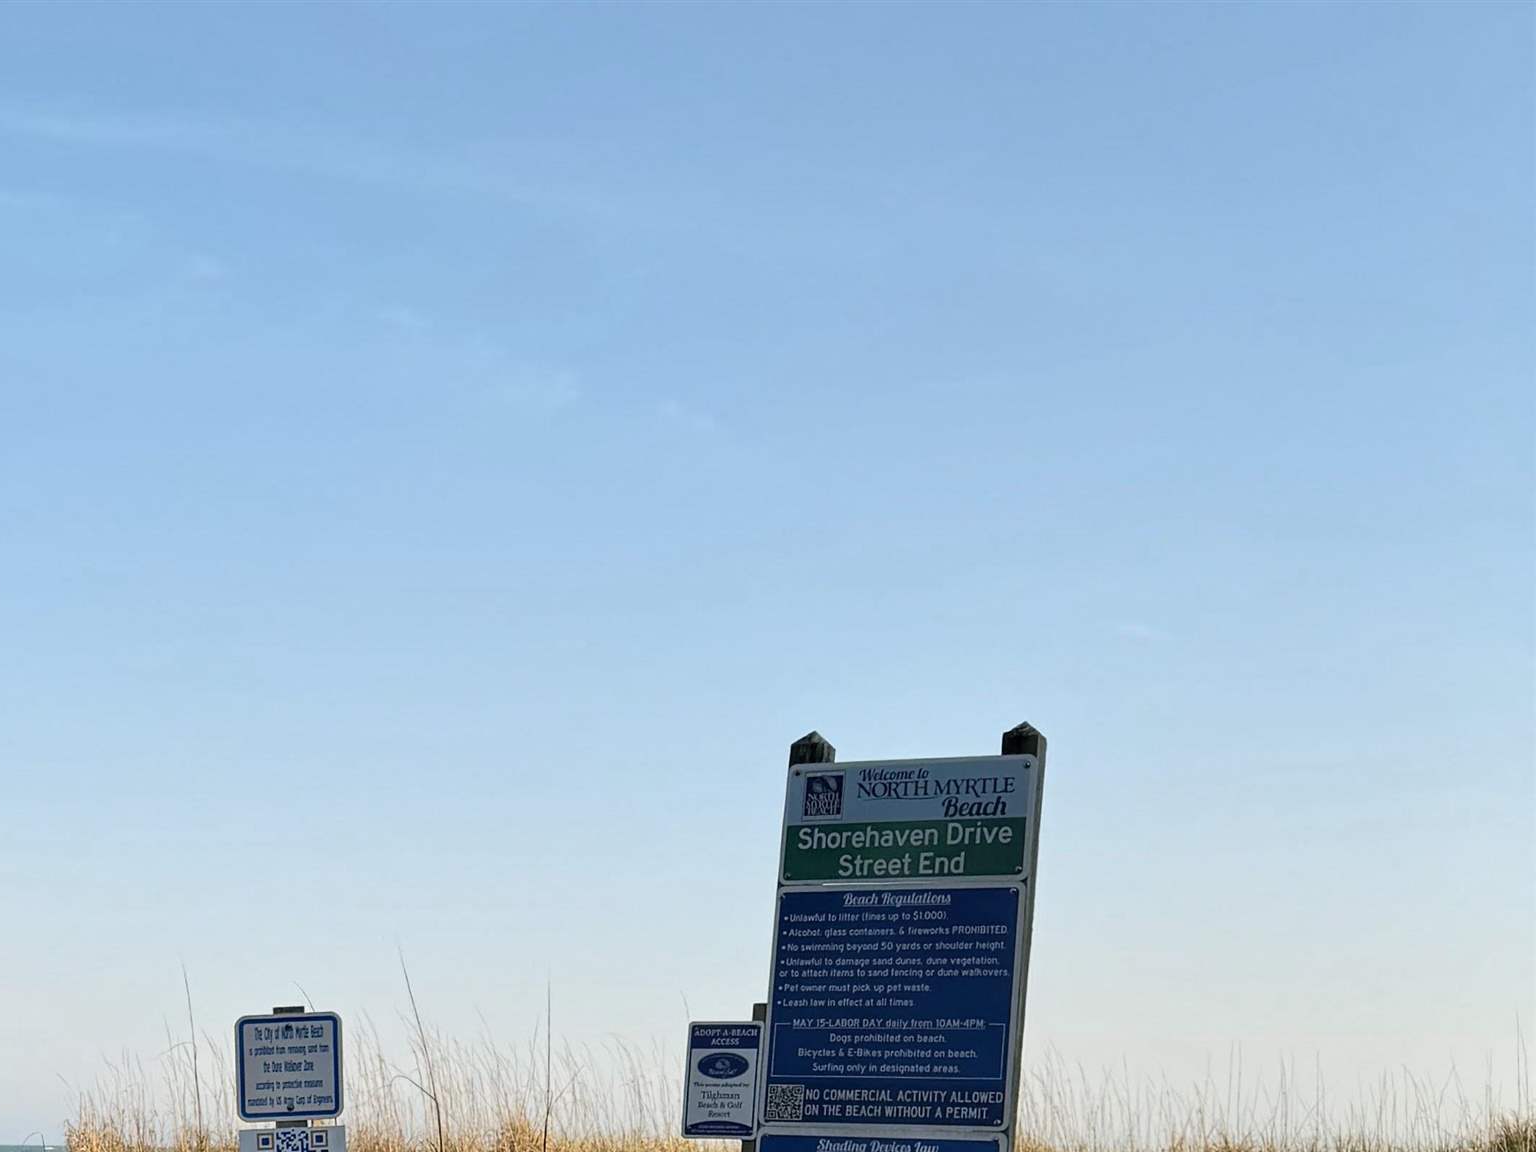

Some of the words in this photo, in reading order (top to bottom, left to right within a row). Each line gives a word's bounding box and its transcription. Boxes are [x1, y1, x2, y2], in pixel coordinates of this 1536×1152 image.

[859, 768, 915, 782] Welcome
[917, 767, 929, 780] to
[857, 780, 929, 799] NORTH
[934, 777, 1016, 798] MYRTLE
[942, 797, 1007, 818] Beach
[798, 826, 938, 850] Shorehaven
[946, 822, 1013, 844] Drive
[838, 854, 912, 876] Street
[918, 852, 965, 874] End
[844, 893, 878, 906] Beach
[882, 892, 951, 907] Regulations
[825, 928, 846, 939] glass
[899, 926, 904, 935] &
[908, 926, 950, 935] fireworks
[801, 943, 844, 953] swimming
[847, 942, 878, 953] beyond
[881, 942, 893, 950] 50
[896, 941, 921, 952] yards
[923, 942, 932, 950] or
[936, 941, 973, 950] shoulder
[793, 1019, 814, 1027] MAY
[863, 1018, 883, 1027] DAY
[886, 1019, 908, 1029] daily
[911, 1019, 932, 1028] from
[694, 1028, 758, 1037] ADOPT-A-BEACH
[830, 1033, 851, 1043] Dogs
[854, 1033, 900, 1043] prohibited
[711, 1038, 740, 1046] ACCESS
[798, 1048, 836, 1059] Bicycles
[839, 1048, 845, 1056] &
[848, 1048, 882, 1057] E-Bikes
[884, 1048, 931, 1059] prohibited
[812, 1062, 844, 1073] Surfing
[847, 1063, 866, 1074] only
[869, 1063, 877, 1071] in
[880, 1063, 930, 1074] designated
[806, 1089, 820, 1100] NO
[824, 1089, 892, 1101] COMMERCIAL
[897, 1090, 947, 1102] ACTIVITY
[950, 1091, 1003, 1103] ALLOWED
[727, 1101, 743, 1110] Golf
[805, 1104, 819, 1116] ON
[823, 1104, 842, 1116] THE
[846, 1105, 881, 1117] BEACH
[885, 1105, 932, 1118] WITHOUT
[935, 1107, 942, 1118] A
[946, 1107, 988, 1119] PERMIT
